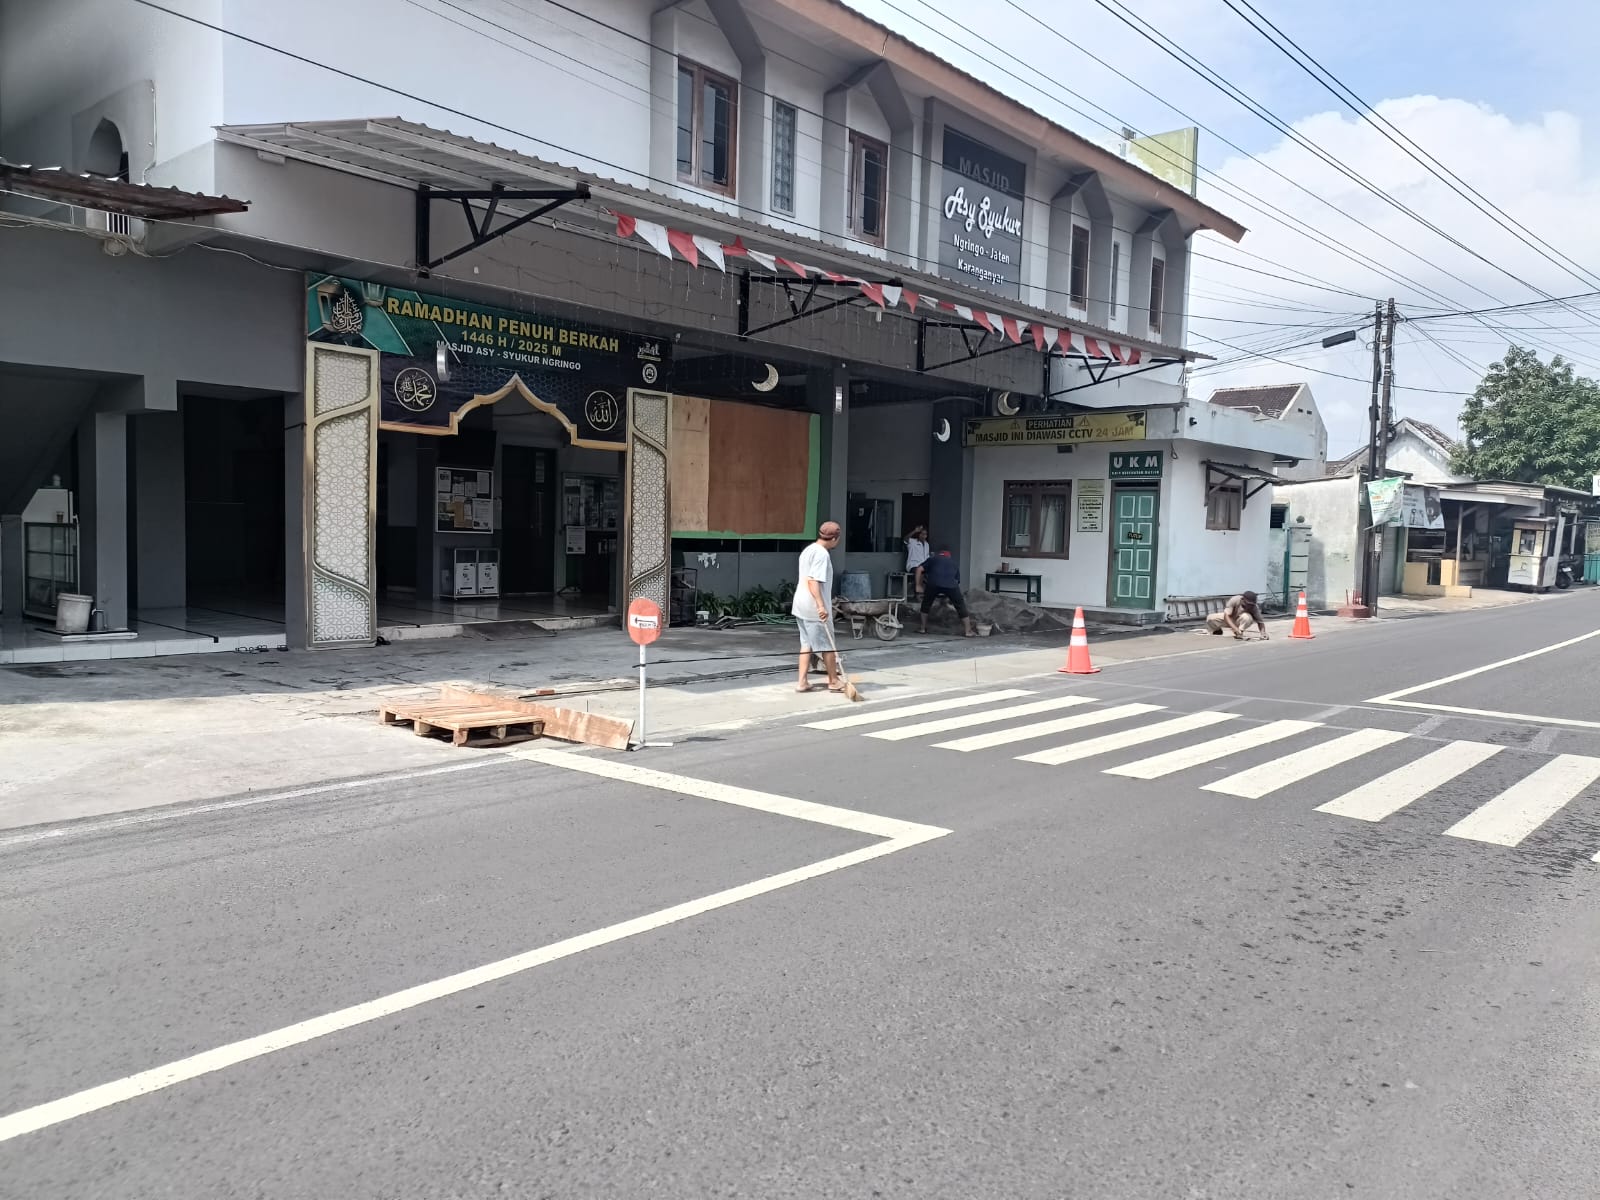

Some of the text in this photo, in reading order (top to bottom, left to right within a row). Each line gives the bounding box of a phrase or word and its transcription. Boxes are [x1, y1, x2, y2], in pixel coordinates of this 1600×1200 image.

[959, 157, 1009, 192] MASJID
[944, 186, 1022, 239] Asy Syukur
[953, 234, 985, 258] Ngringo
[989, 247, 1011, 265] Jaten
[957, 258, 1005, 285] Karanganyar
[387, 296, 493, 330] RAMADHAN
[498, 317, 554, 341] PENUH
[558, 328, 620, 353] BERKAH
[461, 330, 494, 345] 1446
[497, 335, 507, 348] H
[518, 339, 548, 355] 2025
[551, 345, 562, 357] M
[475, 347, 495, 358] ASY
[502, 350, 540, 364] SYUKUR
[542, 357, 582, 371] NGRINGO
[975, 426, 1134, 443] MASJID INI DIAWASI CCTV 24 JAM
[1028, 418, 1073, 430] PERHATIAN
